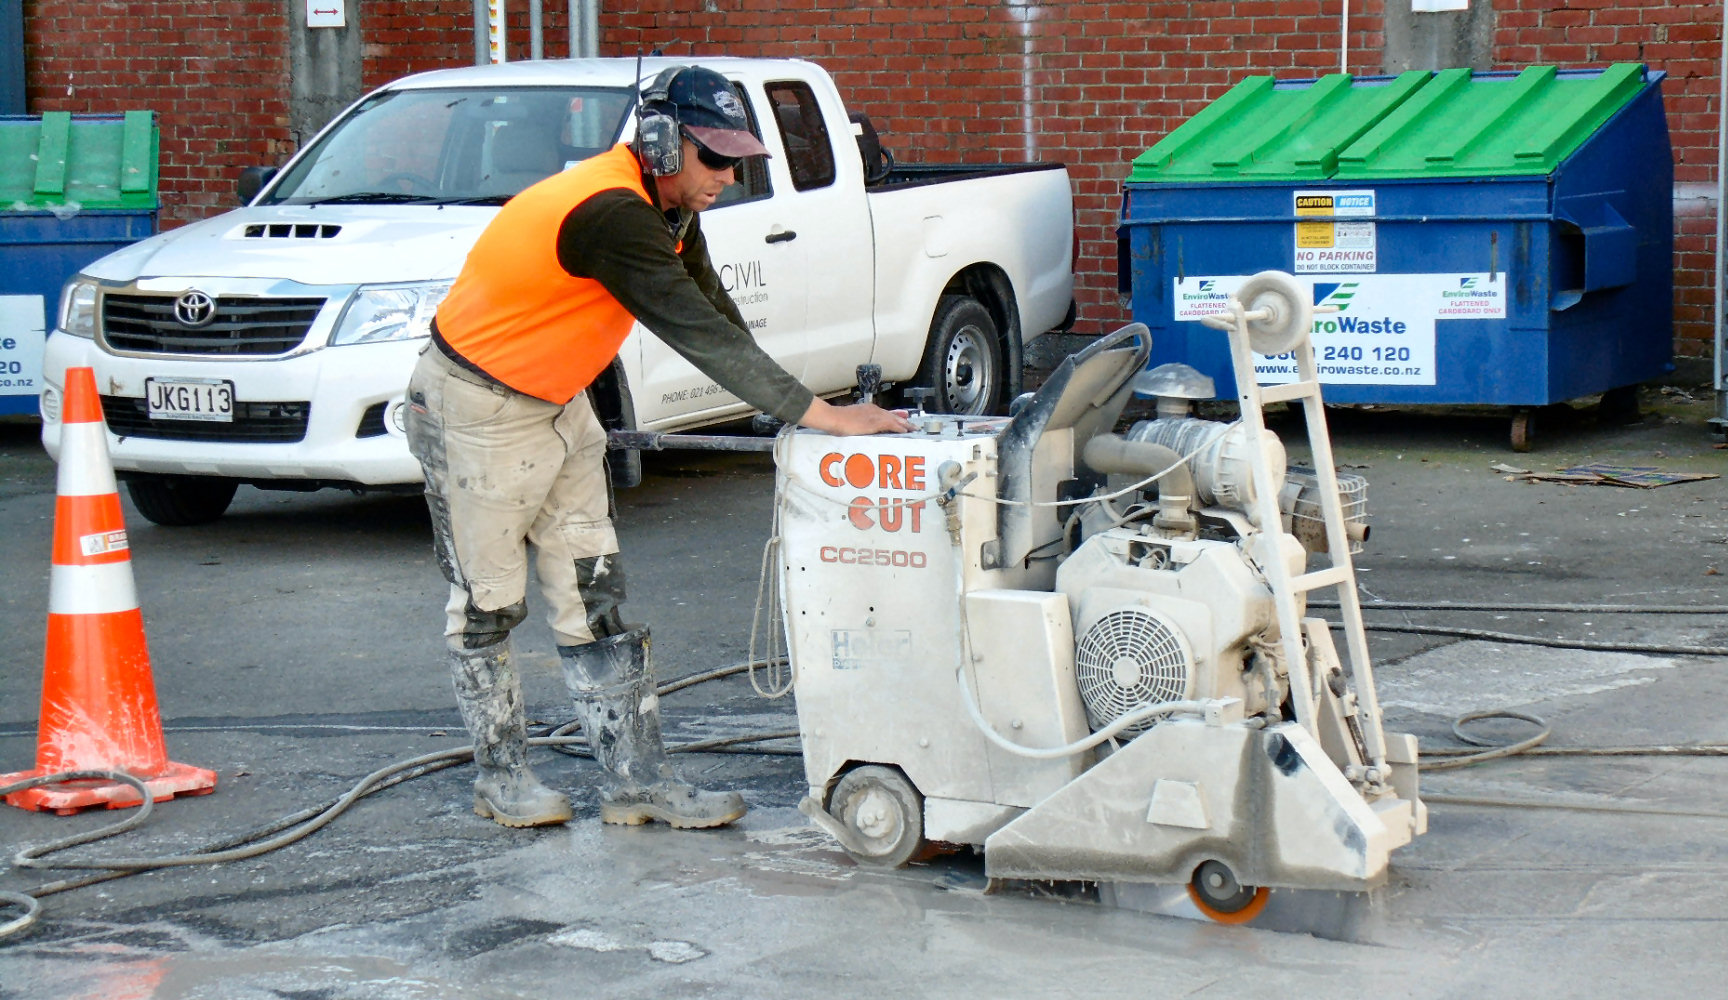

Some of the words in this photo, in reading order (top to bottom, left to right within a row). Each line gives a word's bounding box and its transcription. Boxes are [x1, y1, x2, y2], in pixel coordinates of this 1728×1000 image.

[1297, 197, 1332, 207] CAUTION
[1340, 197, 1370, 206] NOTICE
[1296, 251, 1314, 261] NO
[1318, 251, 1374, 261] PARKING
[719, 260, 766, 292] CIVIL
[1183, 292, 1229, 300] EnviroWast
[1442, 290, 1497, 298] EnviroWaste
[1323, 346, 1363, 361] 240
[1371, 346, 1410, 361] 120
[1254, 362, 1421, 375] www.eirowaste.co.nz
[151, 385, 231, 413] JKG113
[819, 452, 926, 491] CORE
[847, 496, 926, 534] CUT
[820, 546, 927, 568] CC2500
